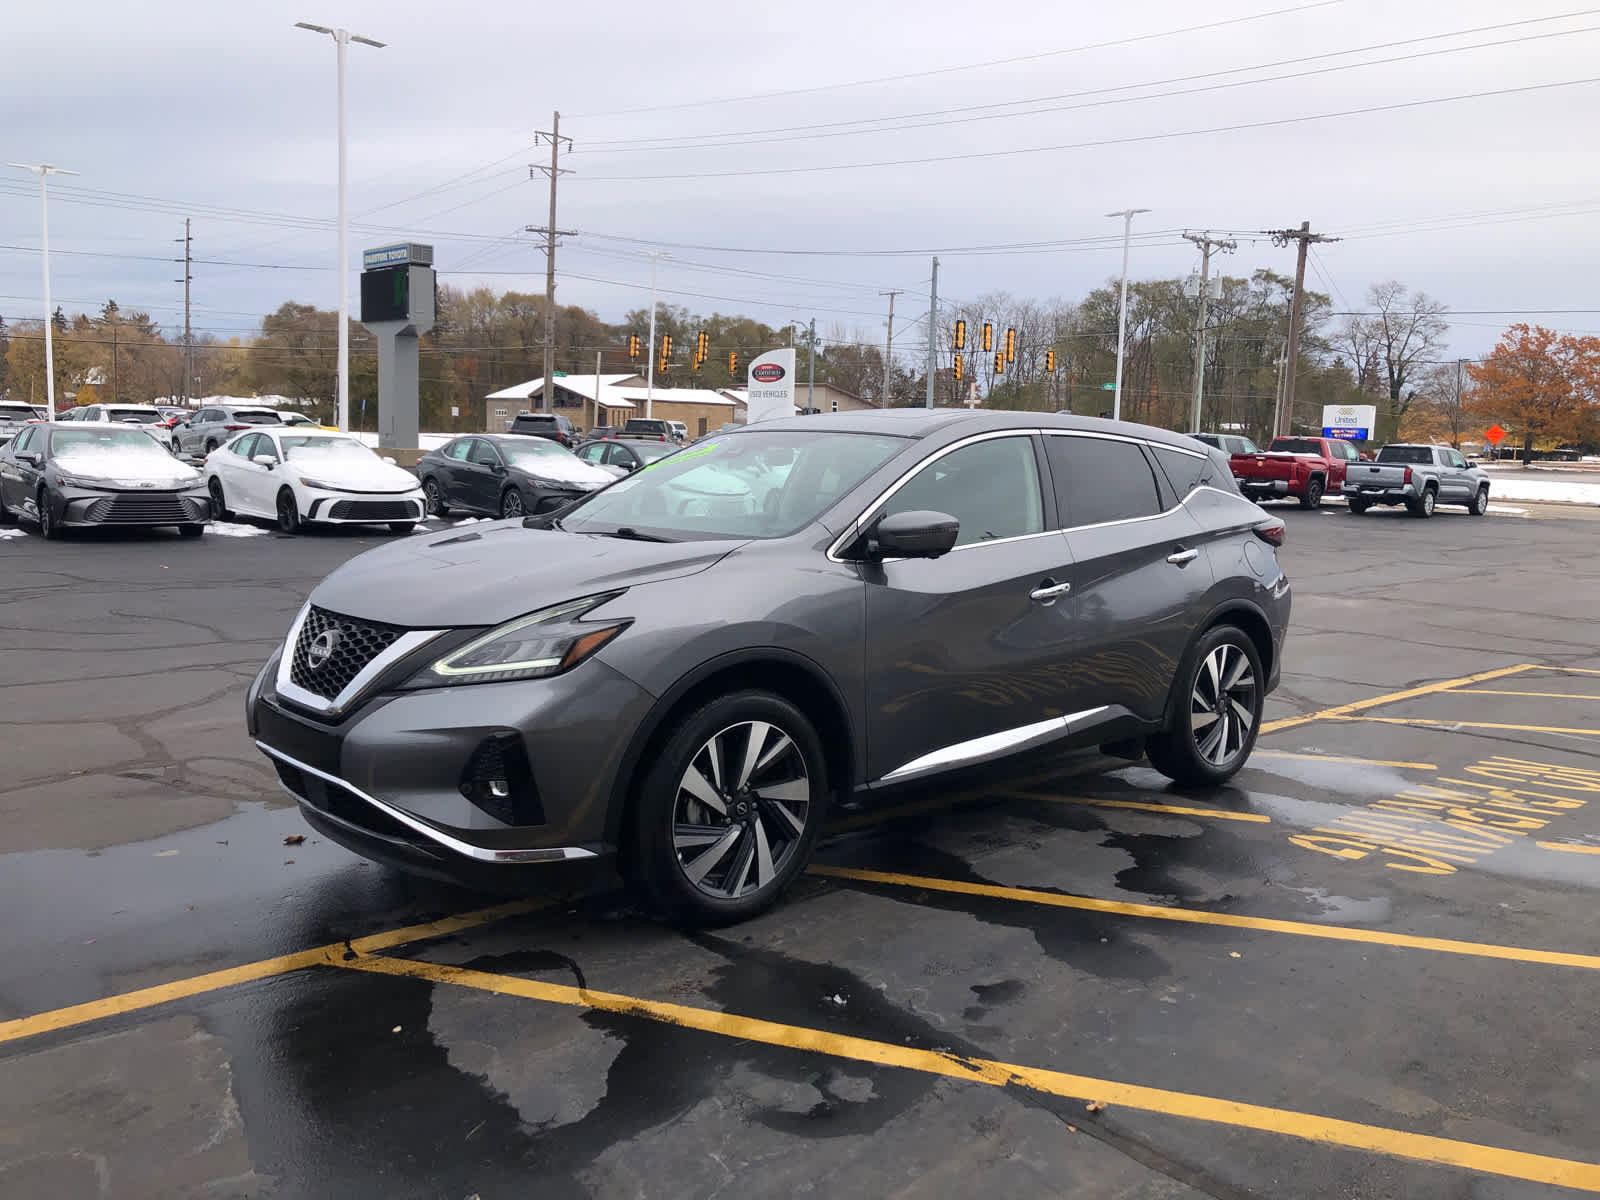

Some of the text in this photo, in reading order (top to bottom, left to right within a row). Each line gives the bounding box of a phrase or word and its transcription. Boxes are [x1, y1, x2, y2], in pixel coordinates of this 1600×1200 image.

[762, 390, 788, 398] VEHICLES
[1334, 416, 1358, 424] United
[1287, 777, 1588, 875] PARKING
